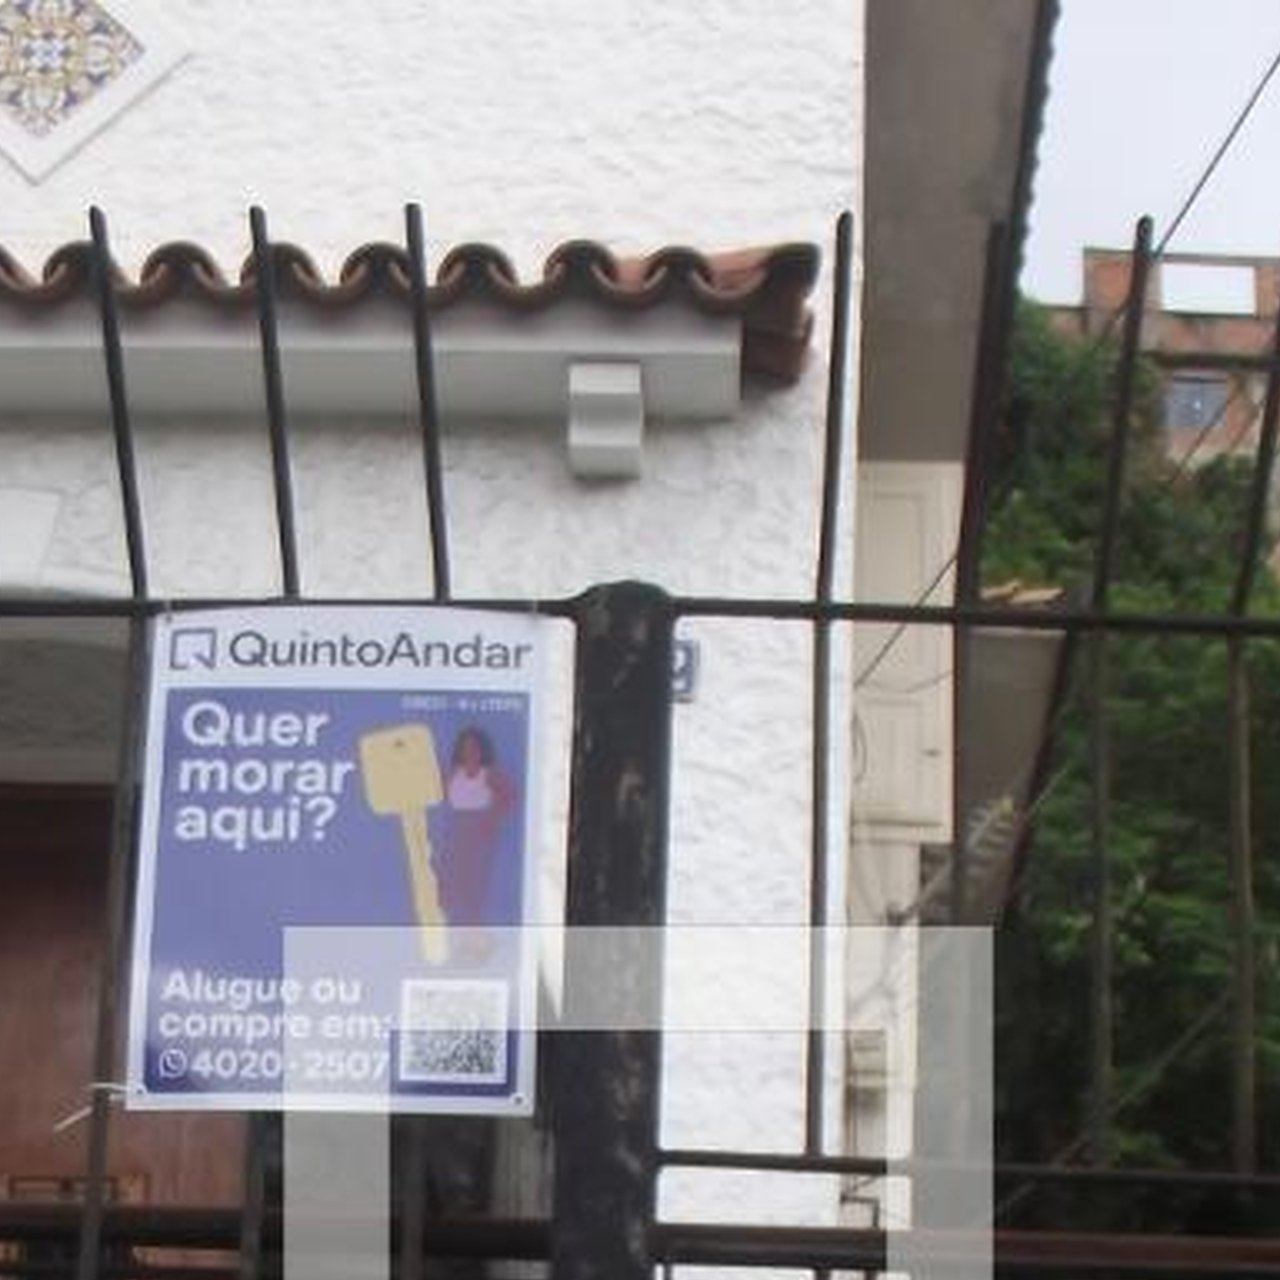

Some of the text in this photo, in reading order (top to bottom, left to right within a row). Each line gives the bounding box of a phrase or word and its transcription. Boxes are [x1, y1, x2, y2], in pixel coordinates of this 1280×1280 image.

[228, 630, 532, 669] QuintoAndar
[182, 700, 329, 747] Quer
[178, 758, 355, 795] morar
[174, 797, 338, 851] aqui?
[160, 968, 362, 1011] Alugue ou
[159, 1011, 312, 1045] compre
